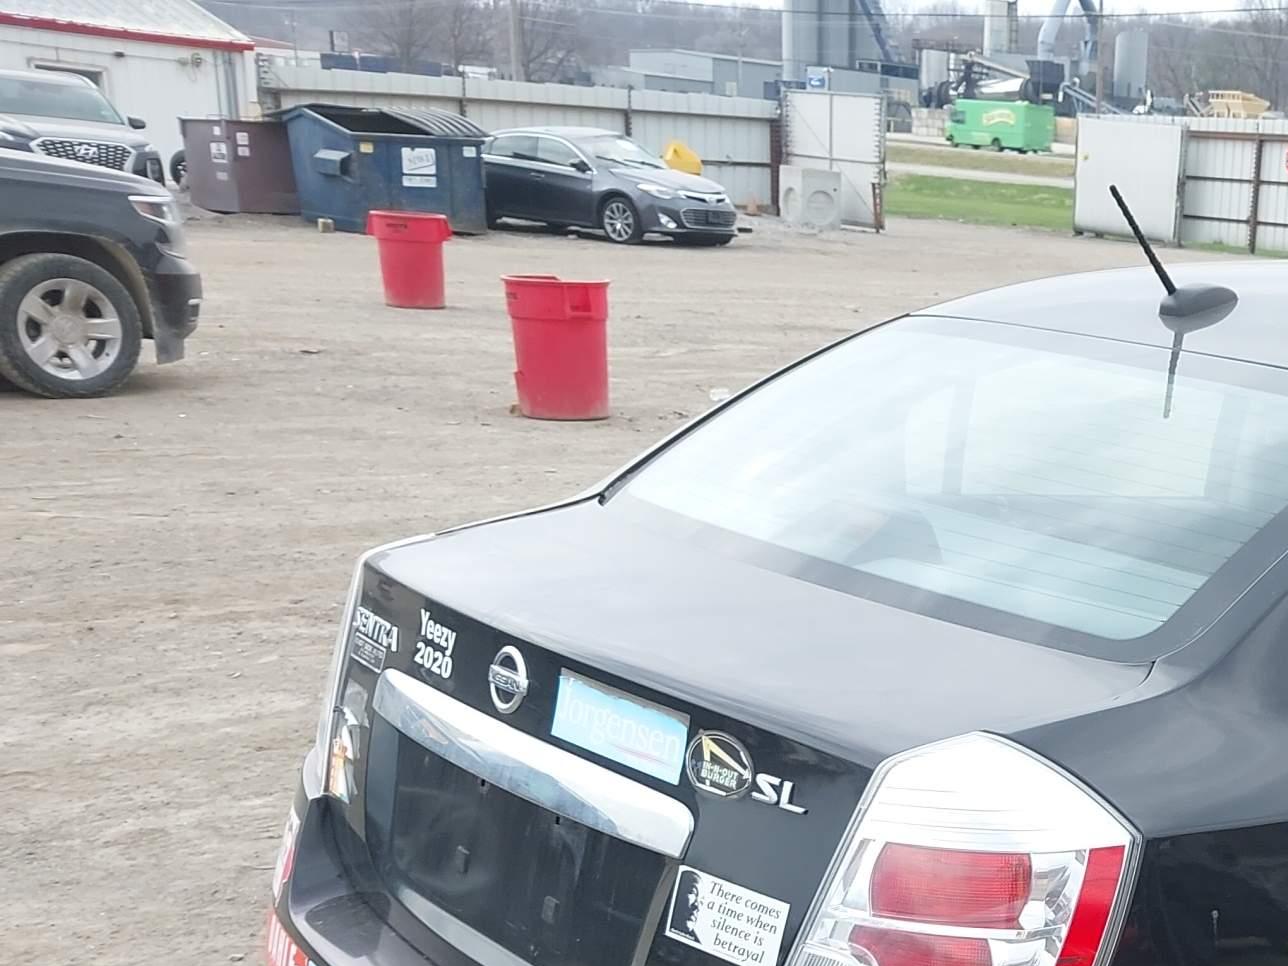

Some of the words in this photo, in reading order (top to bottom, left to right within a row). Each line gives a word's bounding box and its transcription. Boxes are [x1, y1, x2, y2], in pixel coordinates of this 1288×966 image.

[352, 606, 398, 652] SENTRA
[420, 608, 457, 657] Yeezy
[414, 641, 453, 679] 2020
[557, 677, 681, 762] Jorgensen
[700, 768, 738, 790] BURGER
[703, 760, 740, 781] IN-N-OUT
[751, 773, 809, 815] SL
[707, 901, 715, 910] a
[717, 901, 744, 921] time
[746, 914, 778, 935] when
[709, 880, 743, 905] There
[744, 898, 782, 920] comes
[710, 916, 752, 941] silence
[753, 930, 764, 947] is
[713, 932, 765, 964] betrayal
